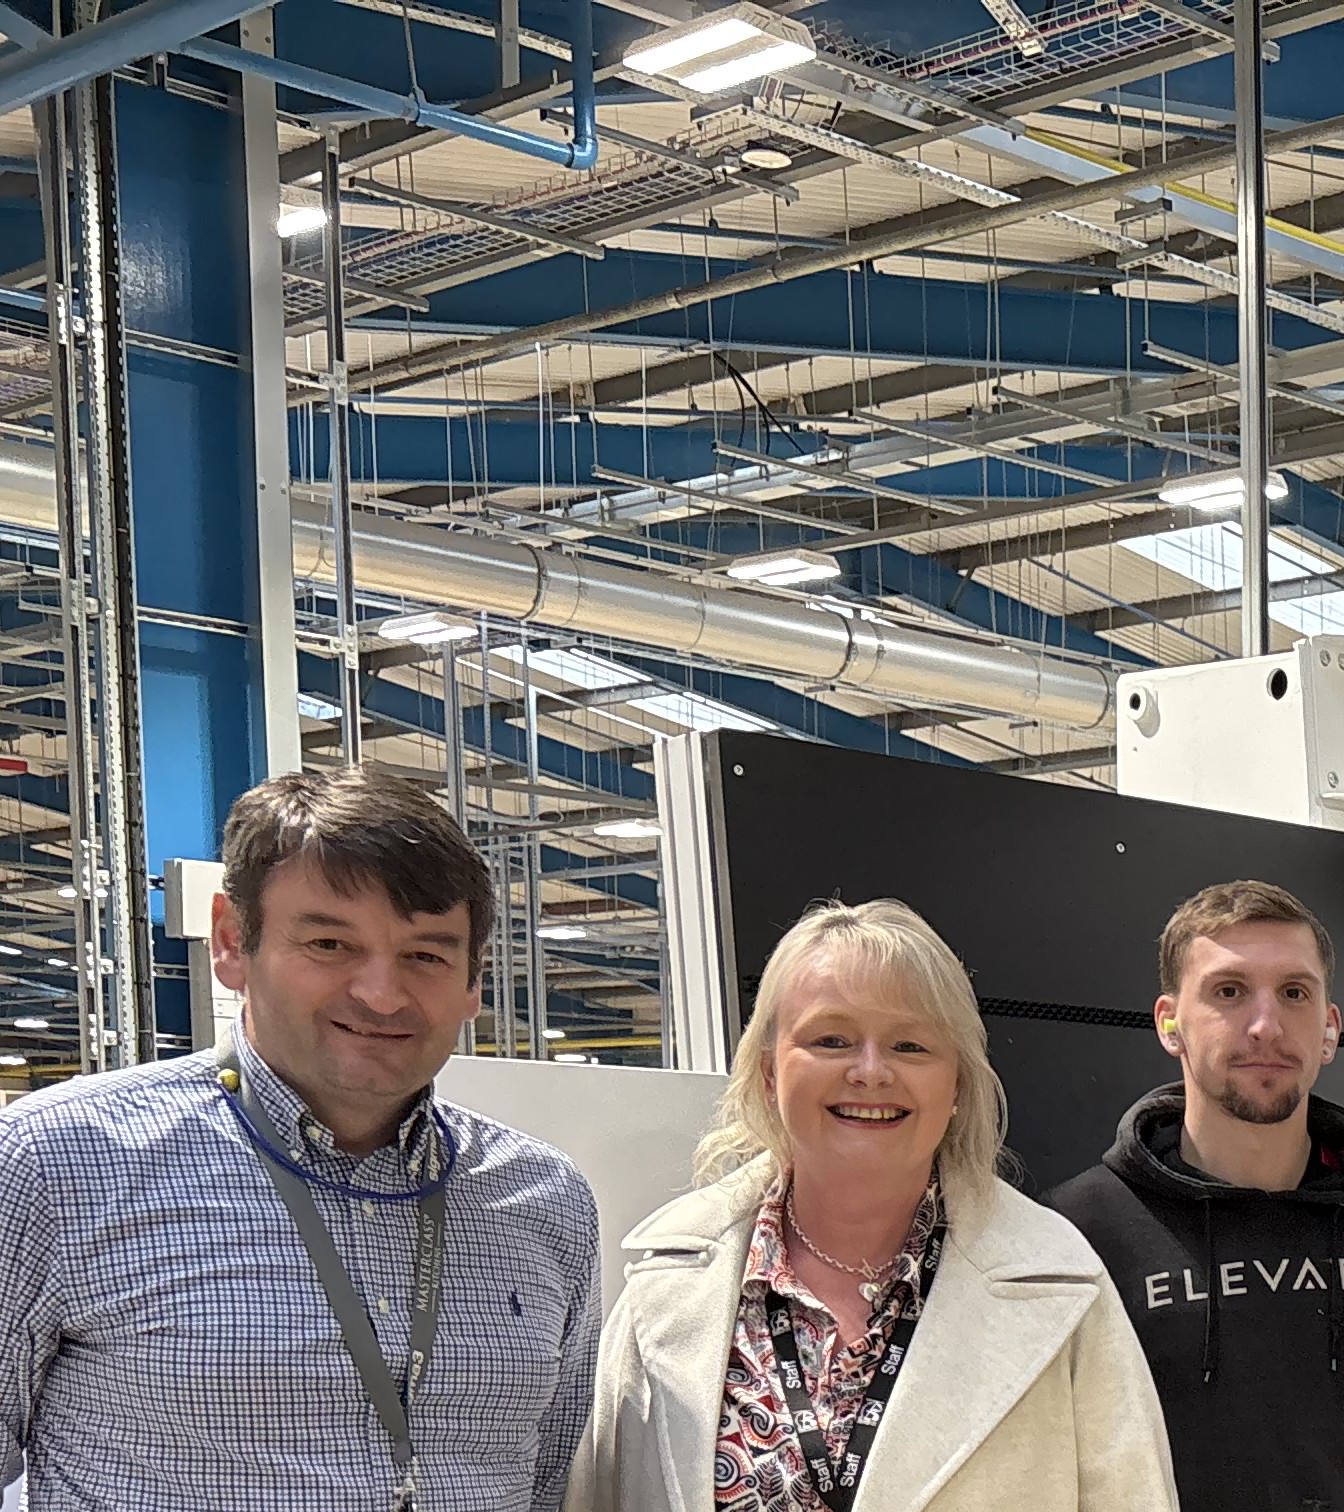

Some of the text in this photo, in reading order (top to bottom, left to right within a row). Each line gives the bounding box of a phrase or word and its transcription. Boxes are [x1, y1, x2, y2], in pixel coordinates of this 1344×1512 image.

[924, 1239, 940, 1272] Staff
[785, 1359, 802, 1391] Staff
[881, 1344, 905, 1377] Staff
[811, 1457, 834, 1494] Staff
[839, 1451, 862, 1489] Staff
